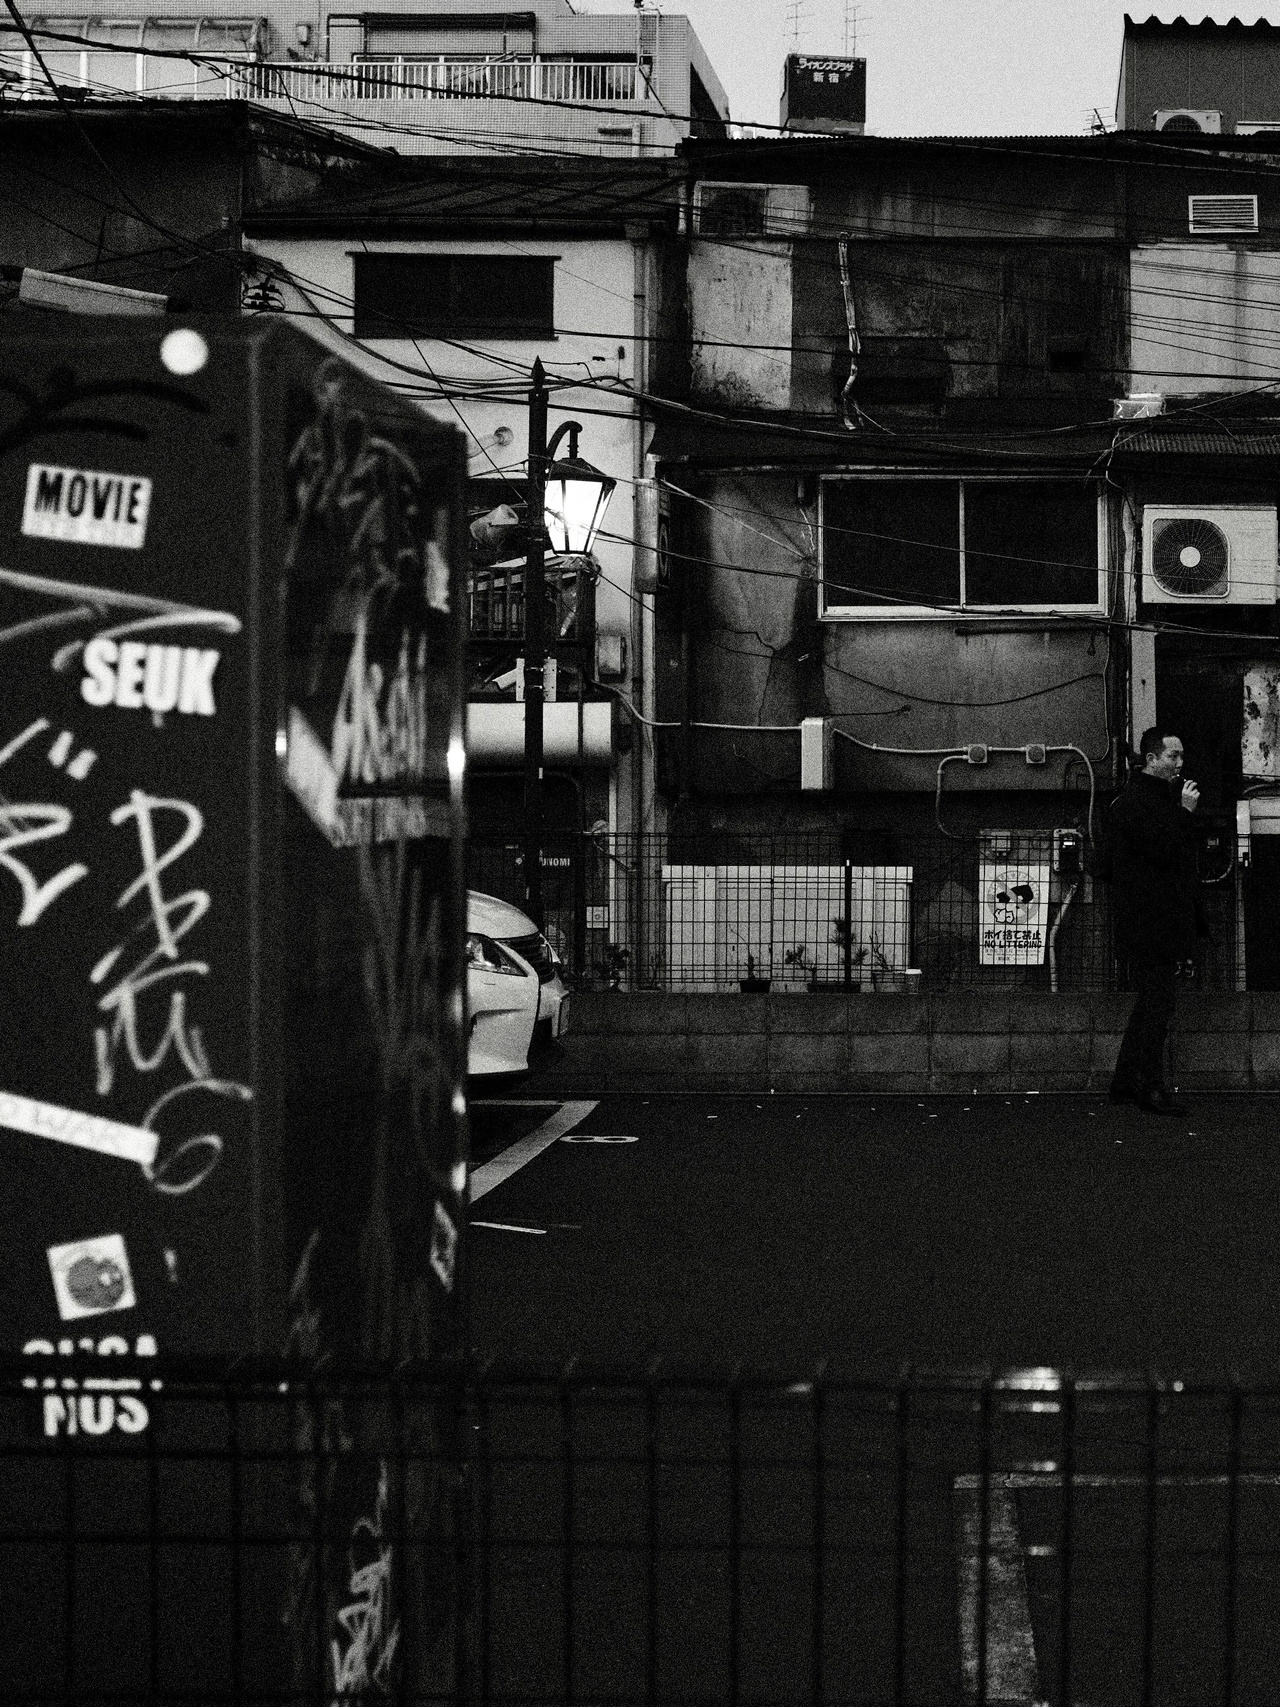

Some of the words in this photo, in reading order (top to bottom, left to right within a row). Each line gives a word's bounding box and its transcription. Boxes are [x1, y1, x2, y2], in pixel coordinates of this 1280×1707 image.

[812, 71, 840, 84] 新宿
[34, 469, 141, 524] MOVIE
[984, 940, 996, 948] NO
